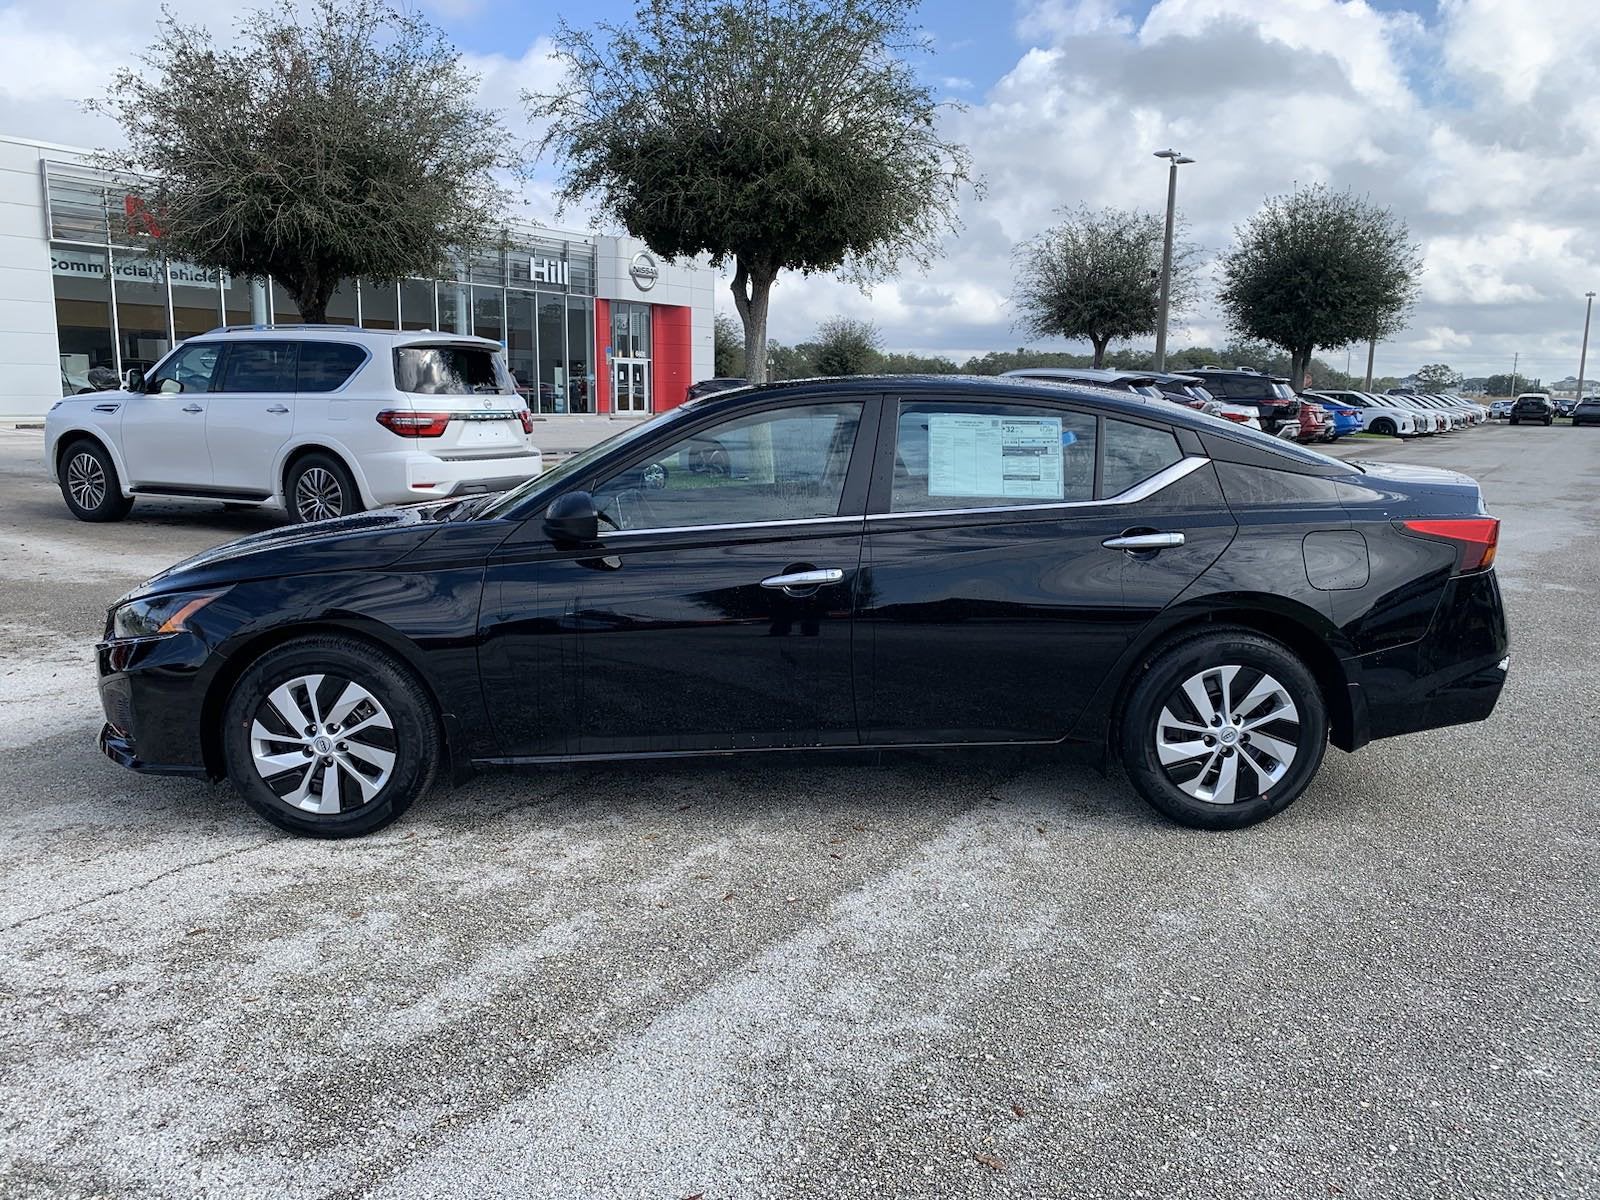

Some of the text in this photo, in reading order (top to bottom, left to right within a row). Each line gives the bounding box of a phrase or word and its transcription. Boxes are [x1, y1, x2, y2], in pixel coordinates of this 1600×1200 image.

[50, 256, 226, 284] Commrcial ehicle
[530, 257, 569, 285] Hill
[633, 265, 657, 275] NISSAN
